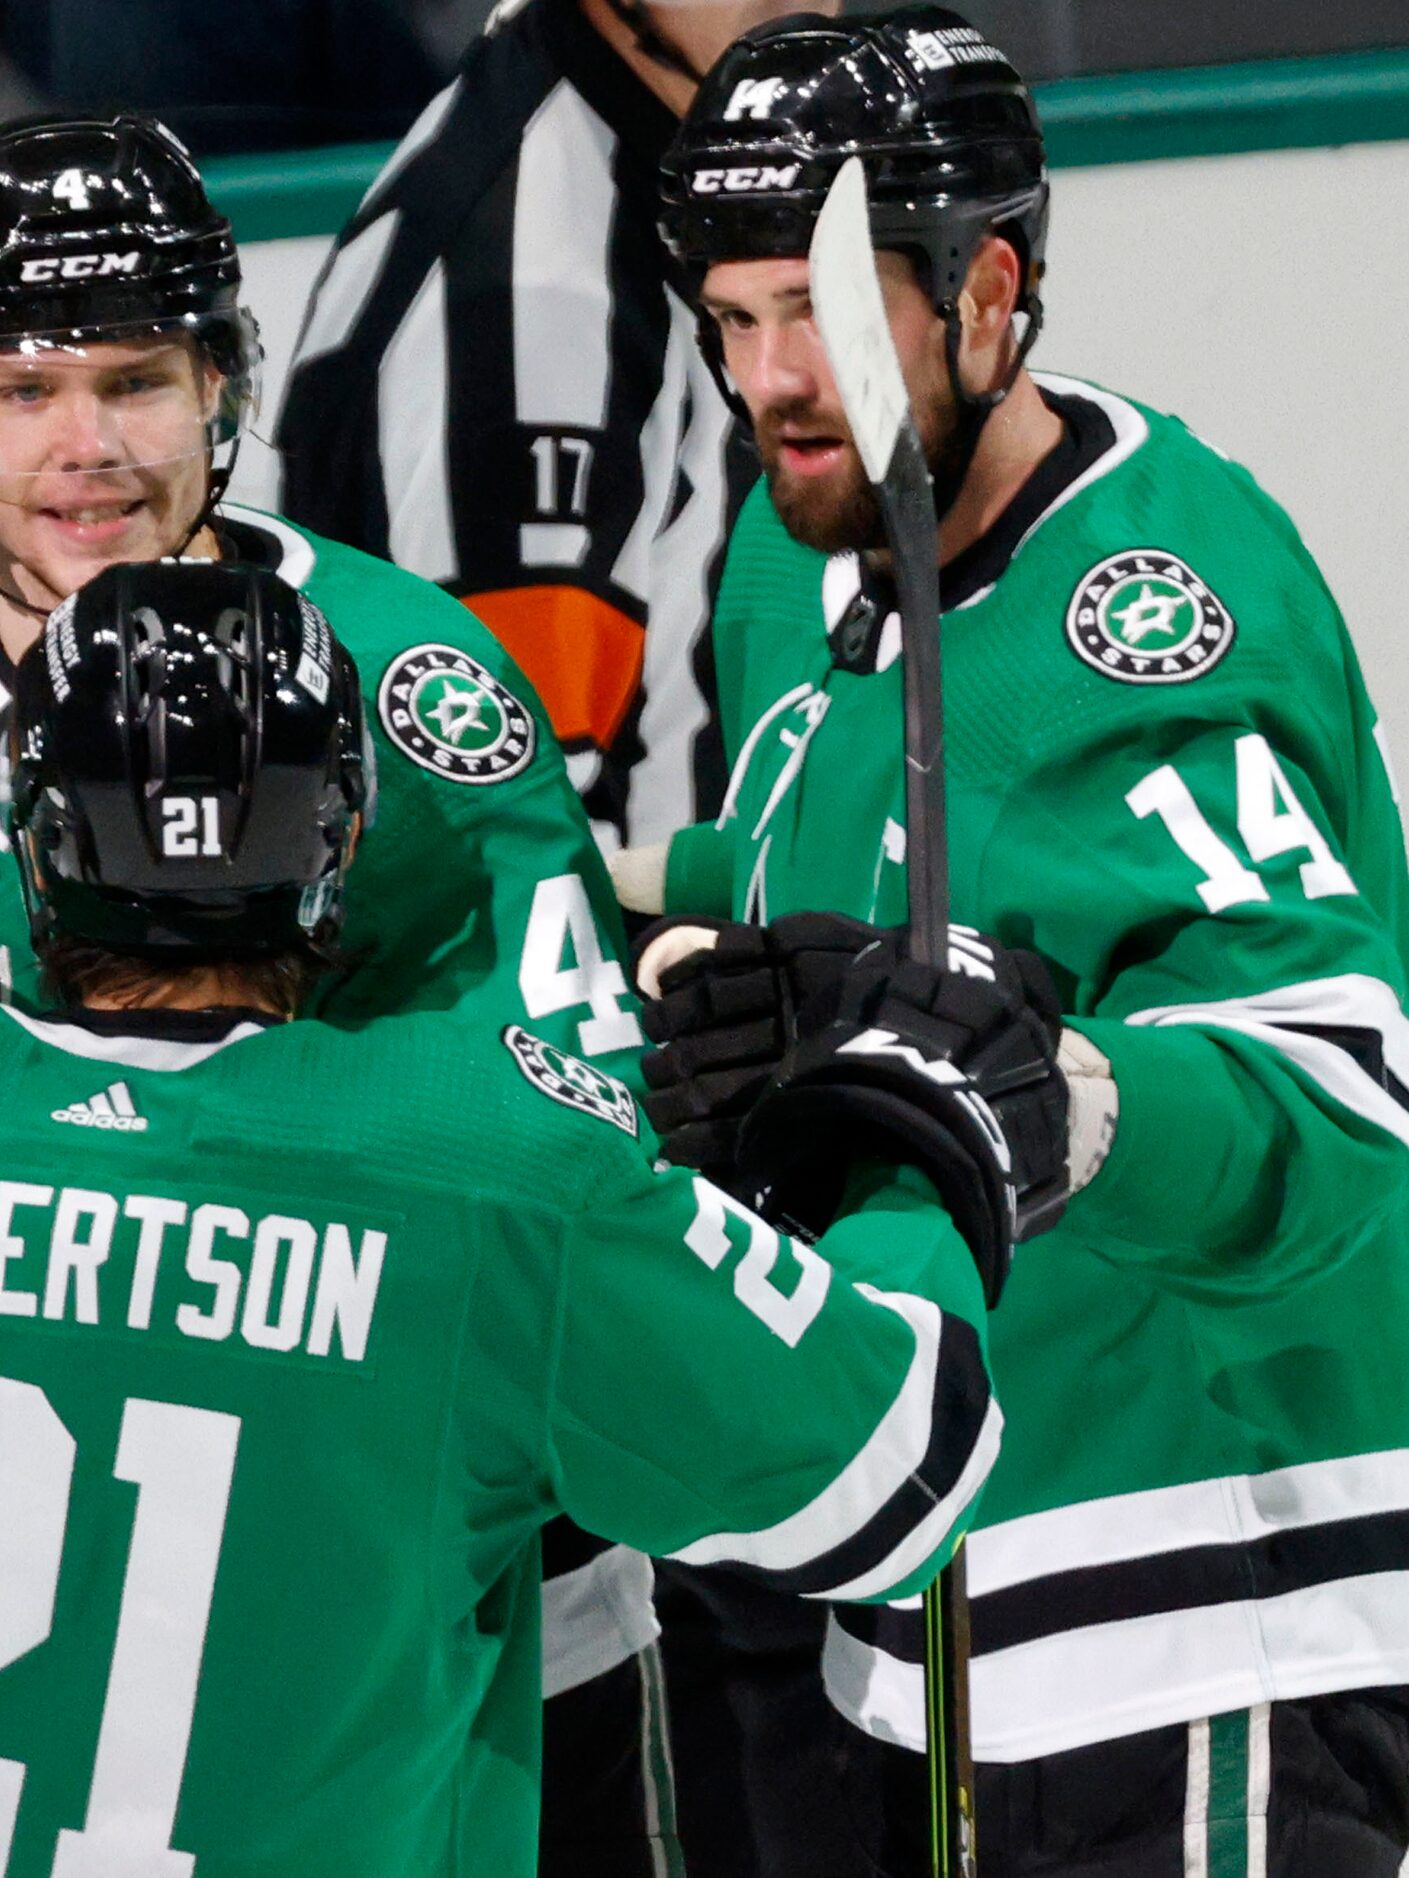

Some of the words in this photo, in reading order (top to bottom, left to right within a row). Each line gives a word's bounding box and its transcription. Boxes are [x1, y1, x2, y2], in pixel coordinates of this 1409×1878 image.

[52, 168, 90, 211] 4
[692, 164, 798, 193] CCM
[19, 251, 141, 283] CCM
[530, 435, 595, 518] 17
[1077, 557, 1208, 627] DALLAS
[1100, 624, 1223, 674] STARS
[391, 653, 496, 730] DALLAS
[432, 717, 529, 773] STARS
[162, 796, 223, 857] 21
[1124, 733, 1359, 914] 14
[518, 872, 645, 1057] 4
[50, 1109, 150, 1132] adidas
